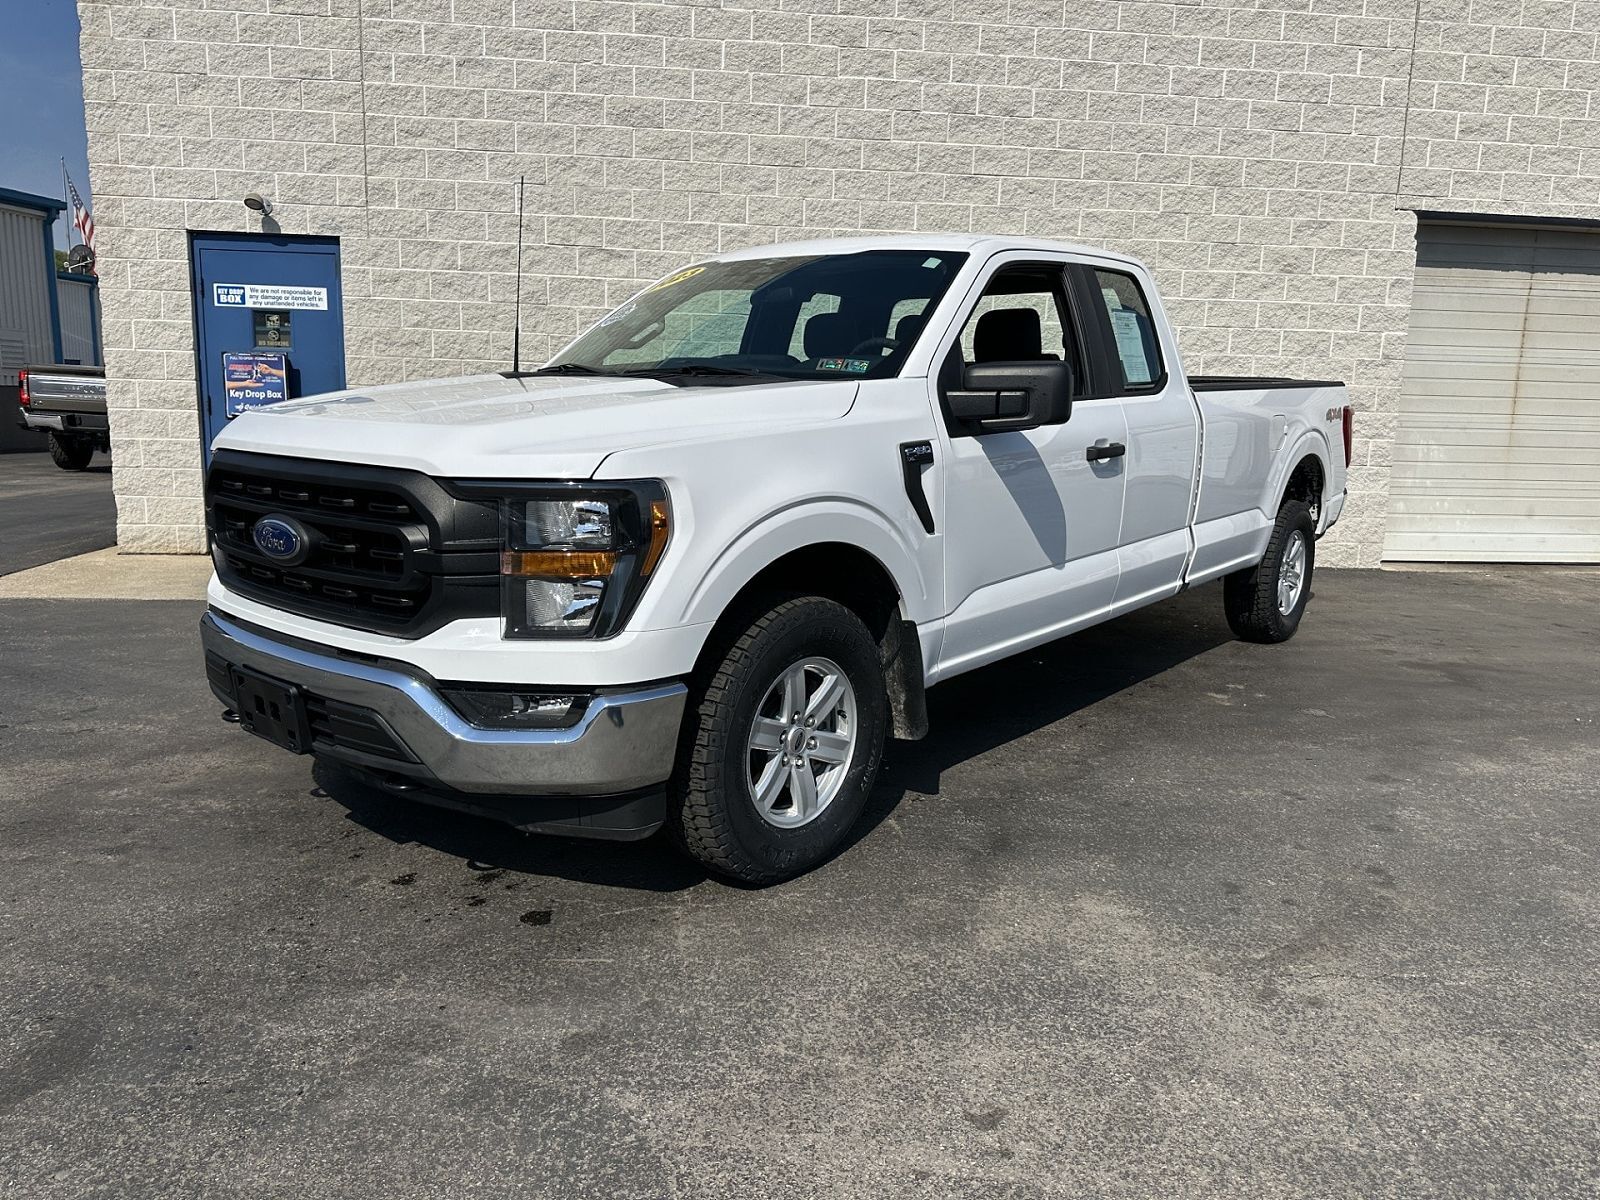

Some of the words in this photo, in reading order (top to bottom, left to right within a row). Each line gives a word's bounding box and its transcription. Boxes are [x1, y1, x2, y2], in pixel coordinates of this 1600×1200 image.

[219, 294, 242, 303] BOX
[230, 389, 244, 398] Key
[245, 389, 265, 399] Drop
[267, 390, 282, 398] Box
[261, 526, 286, 550] Ford
